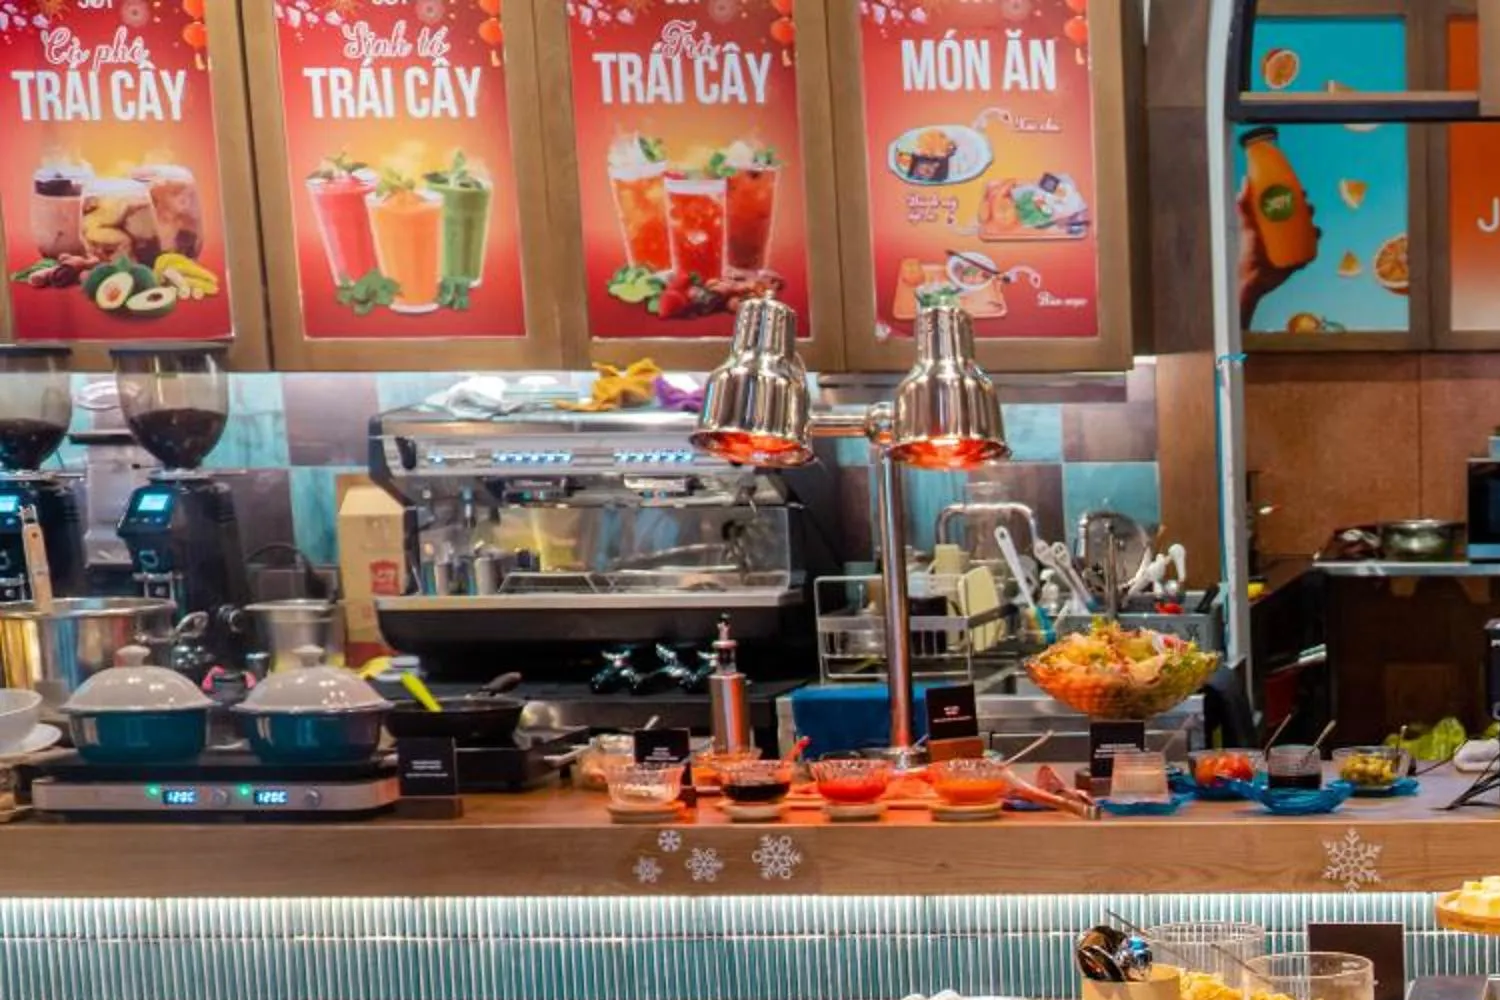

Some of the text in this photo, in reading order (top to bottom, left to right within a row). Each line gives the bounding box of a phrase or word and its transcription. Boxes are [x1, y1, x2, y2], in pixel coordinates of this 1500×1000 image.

[11, 60, 187, 121] TRÁI CÂY
[303, 56, 482, 119] TRÁI CÂY
[591, 41, 773, 105] TRÁI CÂY
[902, 28, 1057, 91] MÓN ĂN
